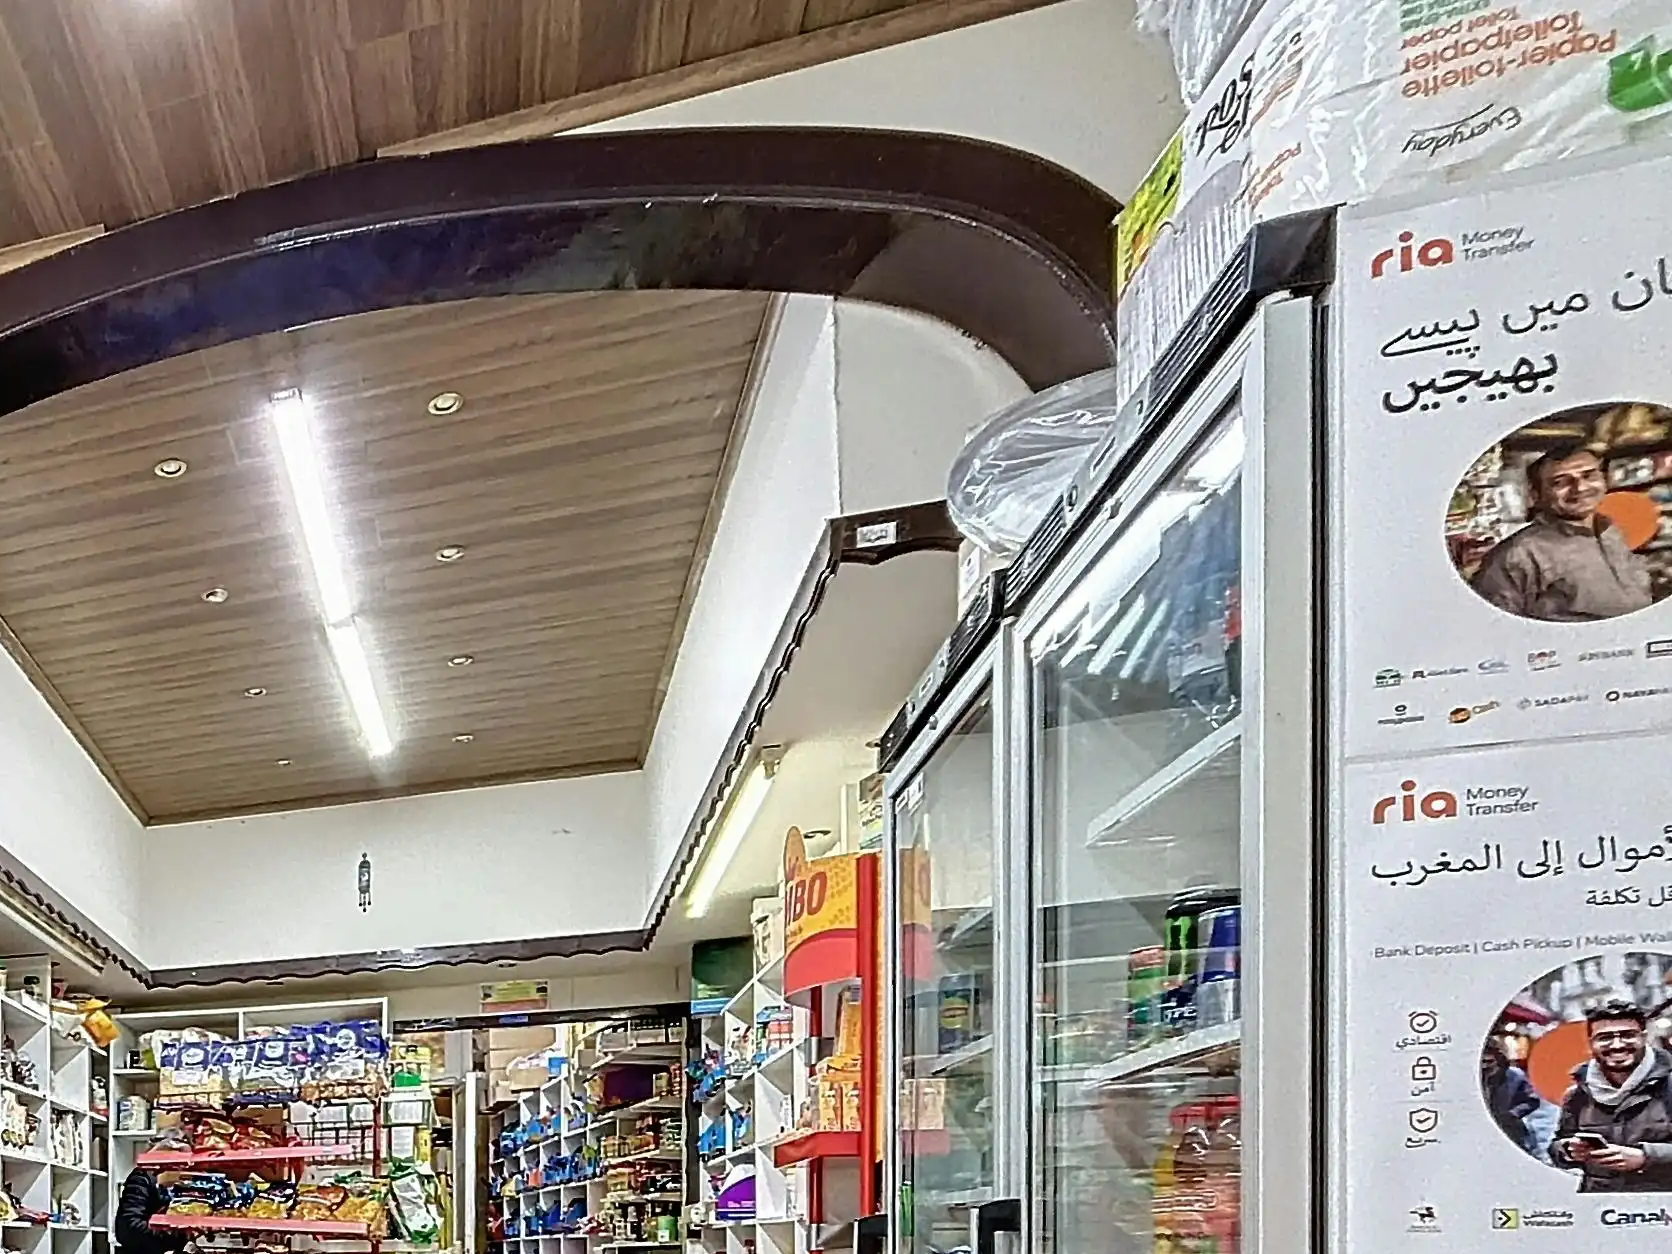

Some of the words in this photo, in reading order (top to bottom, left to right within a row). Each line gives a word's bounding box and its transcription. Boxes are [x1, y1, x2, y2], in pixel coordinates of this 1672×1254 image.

[1402, 9, 1584, 75] Toiletpapier
[1402, 29, 1619, 99] Papier-toilette
[1402, 106, 1522, 157] Everyday
[1370, 231, 1454, 279] ria
[1462, 225, 1524, 246] Money
[1462, 238, 1535, 261] Transfer
[1372, 779, 1458, 825] ria
[1466, 786, 1528, 803] Money
[1466, 799, 1540, 818] Transfer
[1371, 843, 1502, 887] المغرب
[1517, 839, 1563, 879] إلى
[785, 870, 828, 927] IBO
[1374, 945, 1412, 959] Bank
[1415, 942, 1471, 957] Deposit
[1481, 939, 1519, 952] Cash
[1600, 1208, 1672, 1226] Canal
